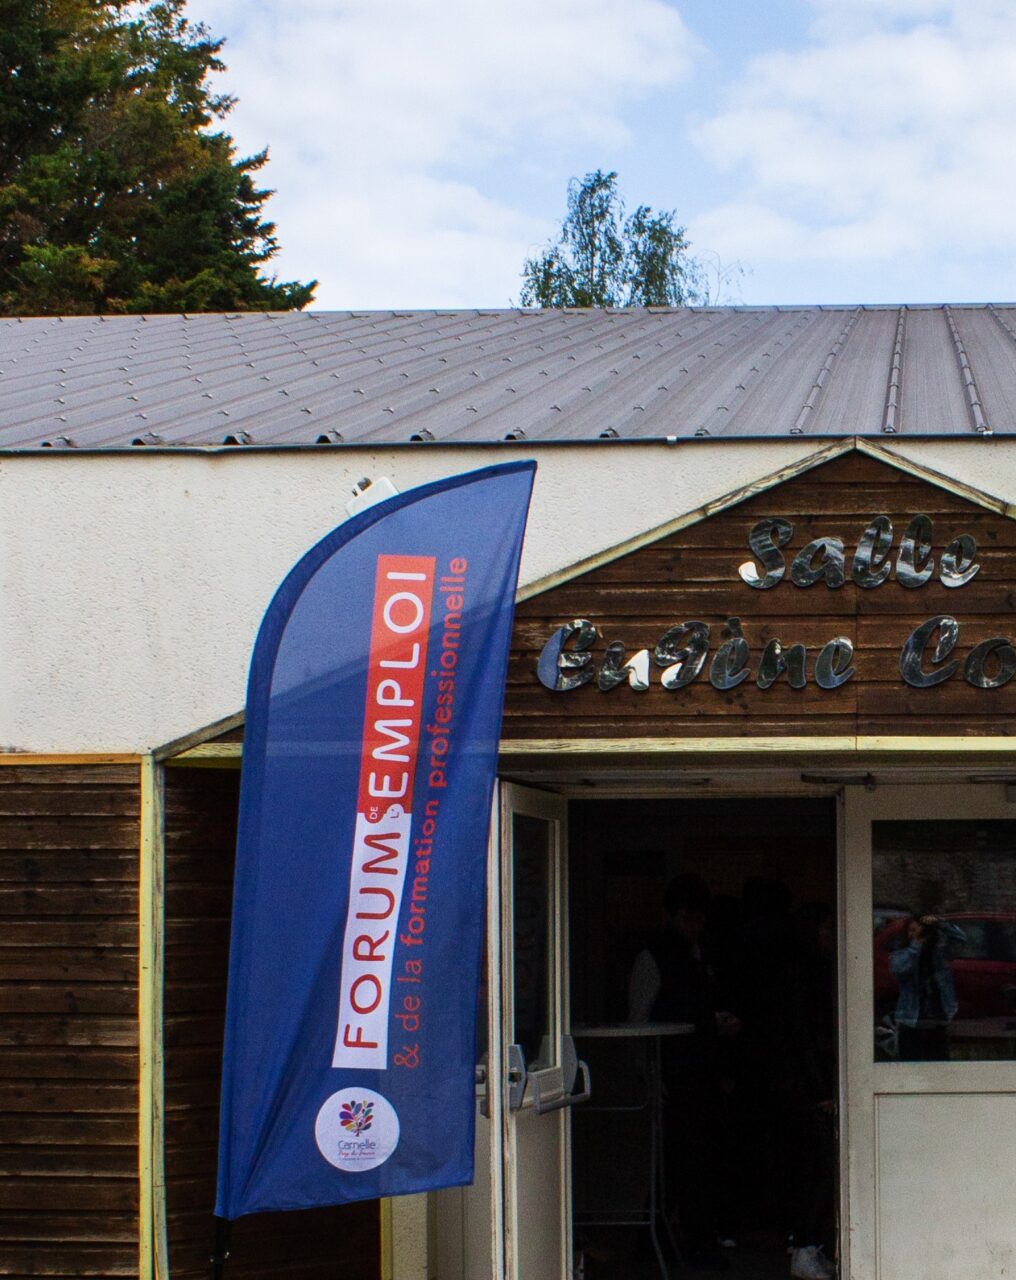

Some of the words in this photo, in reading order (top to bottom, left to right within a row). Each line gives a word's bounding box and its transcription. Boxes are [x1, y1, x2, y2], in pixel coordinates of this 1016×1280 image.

[738, 514, 981, 589] Salle
[367, 571, 427, 798] EMPLOI
[426, 556, 468, 788] professionnelle
[536, 616, 855, 690] Eugène
[400, 800, 440, 946] formation
[343, 831, 402, 1050] FORUM
[397, 959, 423, 983] la
[394, 995, 421, 1032] de
[393, 1043, 421, 1069] &
